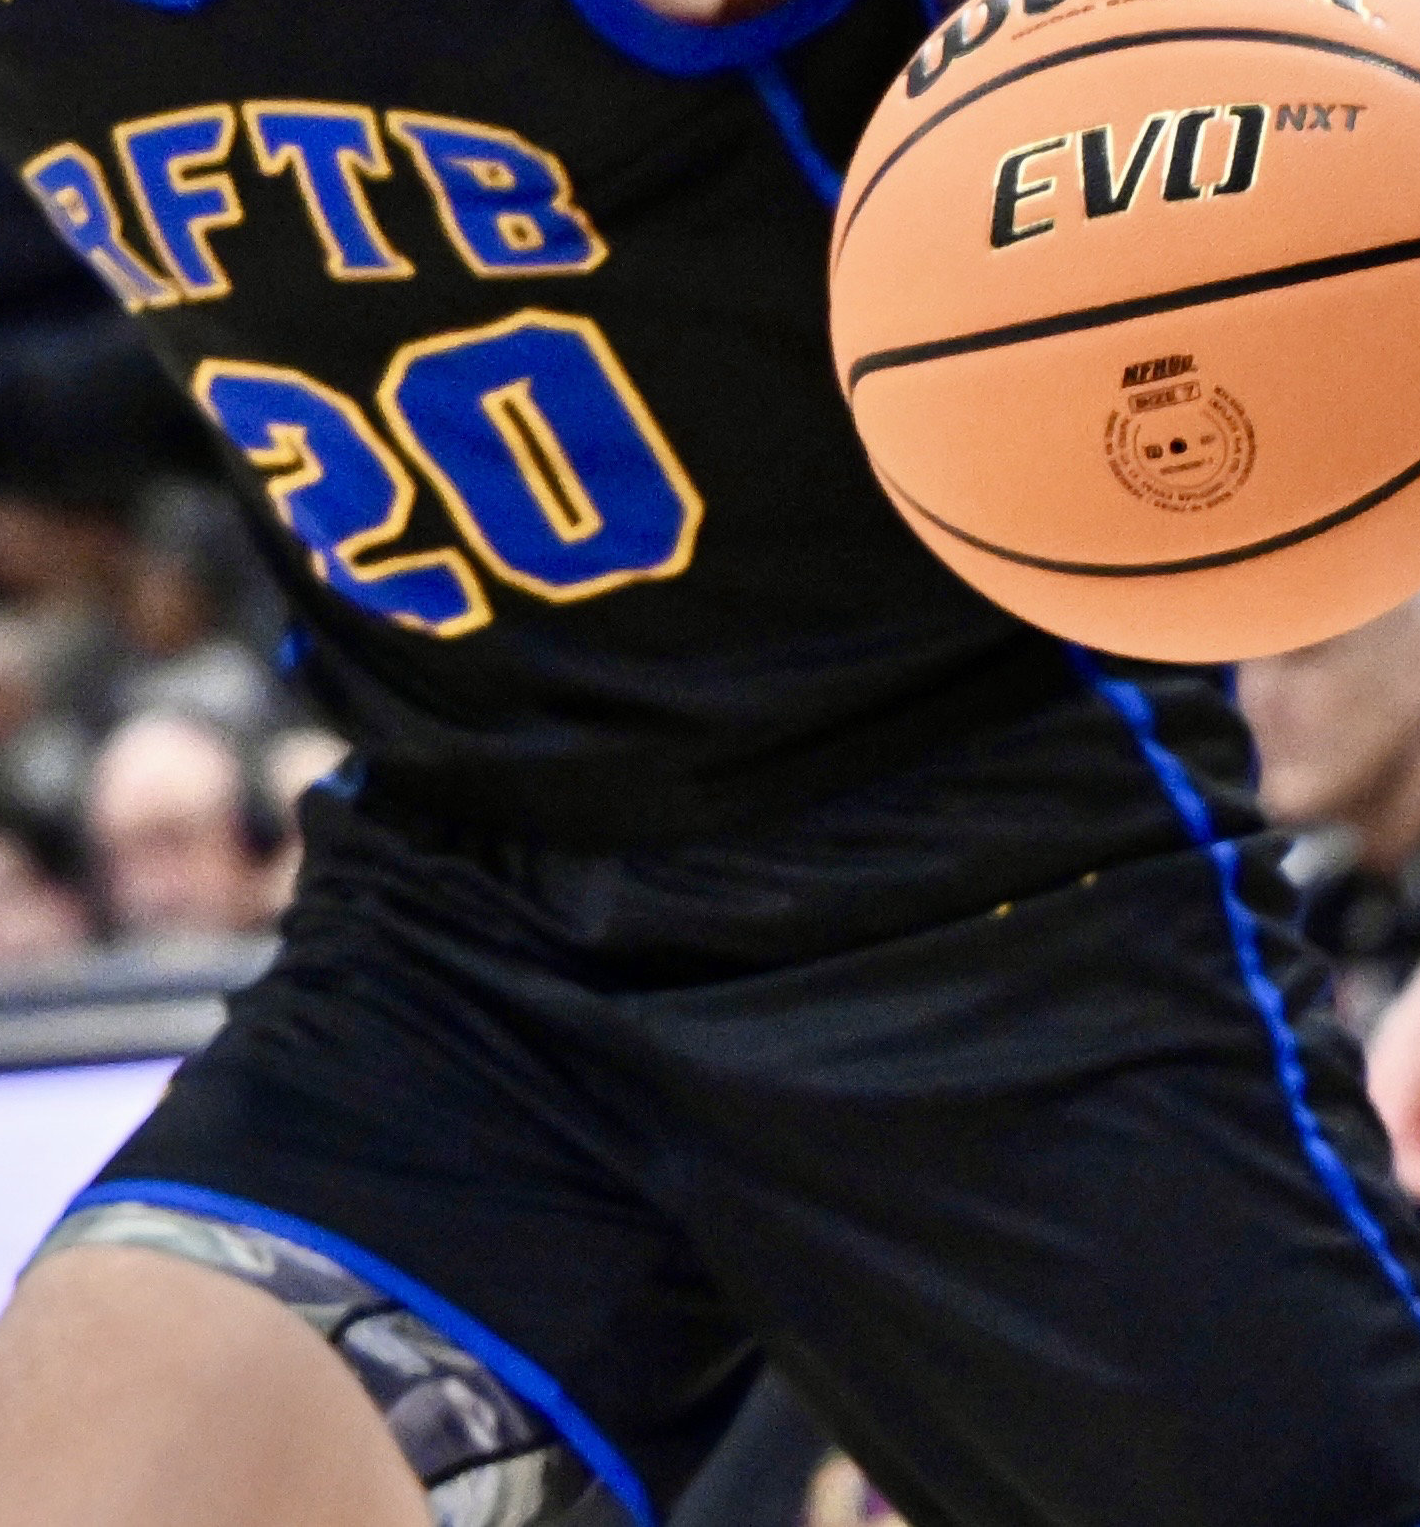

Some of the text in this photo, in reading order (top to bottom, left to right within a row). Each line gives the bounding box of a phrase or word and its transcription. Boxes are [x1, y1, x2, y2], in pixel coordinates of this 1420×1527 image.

[21, 98, 611, 314] RFTB
[1274, 102, 1367, 133] NXT
[190, 306, 707, 640] 20
